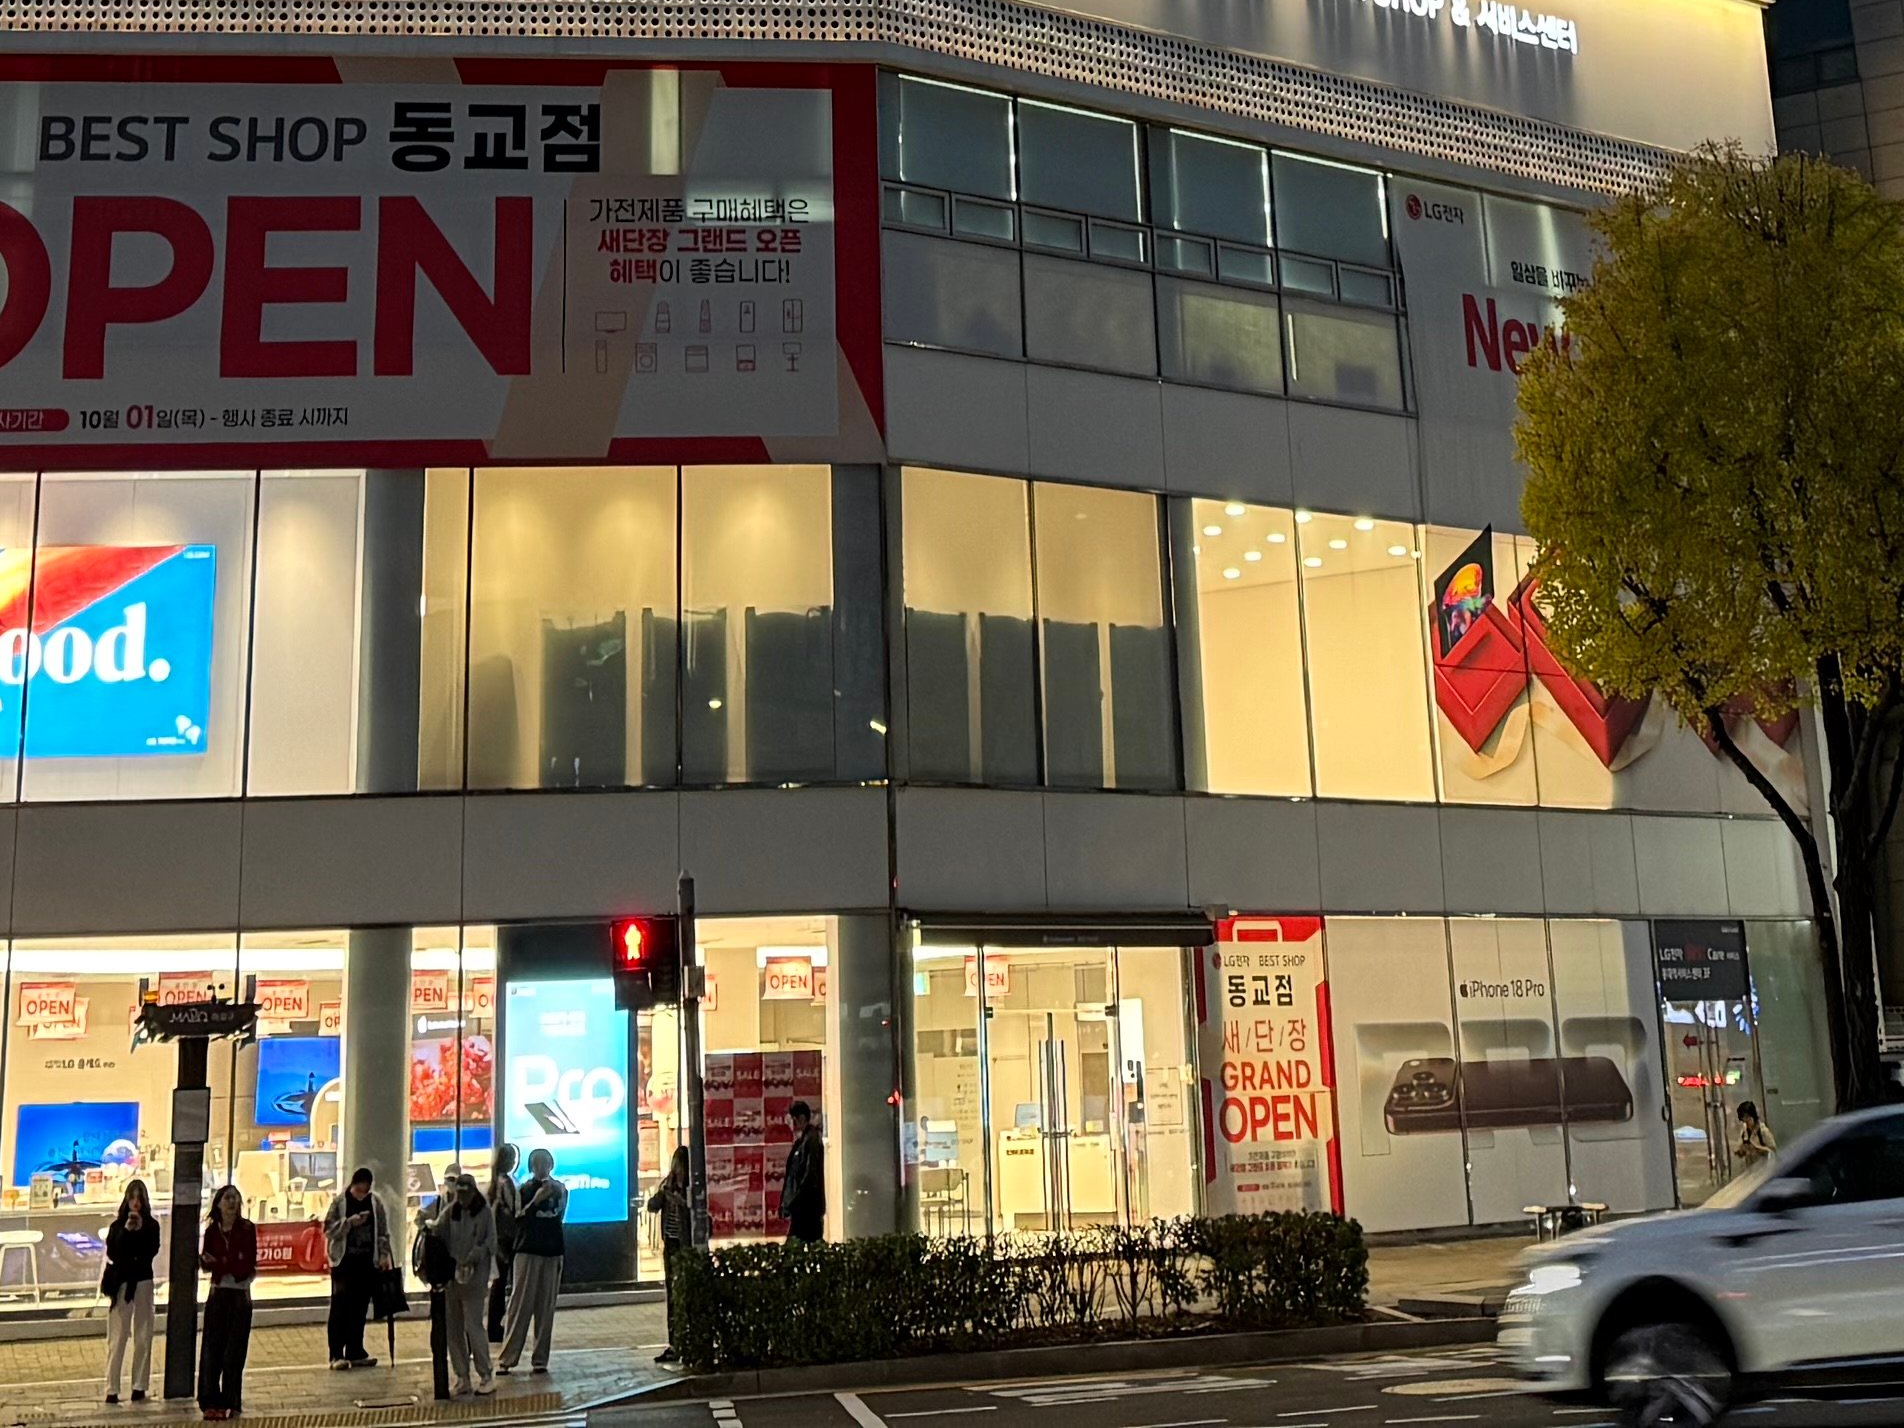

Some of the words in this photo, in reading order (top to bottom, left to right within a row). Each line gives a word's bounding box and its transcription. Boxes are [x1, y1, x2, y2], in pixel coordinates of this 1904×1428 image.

[39, 115, 190, 163] BEST
[206, 115, 368, 164] SHOP
[388, 101, 603, 174] 동교점
[589, 197, 684, 224] 가전제품
[1423, 200, 1465, 225] LG전자
[597, 228, 670, 254] 새단장
[676, 228, 748, 254] 그랜드
[755, 228, 802, 254] 오픈
[609, 258, 681, 284] 혜택이
[689, 257, 791, 284] 좋습니다!
[79, 409, 120, 430] 10월
[221, 408, 256, 429] 행사
[260, 408, 295, 428] 종료
[298, 406, 349, 428] 시까지
[1223, 954, 1251, 968] LG전자
[1258, 954, 1280, 967] BEST
[1282, 953, 1306, 966] SHOP
[413, 987, 443, 1003] PEN
[769, 974, 808, 991] OPEN
[1226, 973, 1294, 1008] 동교점
[1469, 979, 1510, 998] iPhone
[1511, 979, 1524, 998] 18
[1525, 978, 1545, 997] Pro
[26, 999, 70, 1016] OPEN
[262, 996, 303, 1012] OPEN
[1219, 1058, 1312, 1092] GRAND
[1218, 1093, 1319, 1144] OPEN
